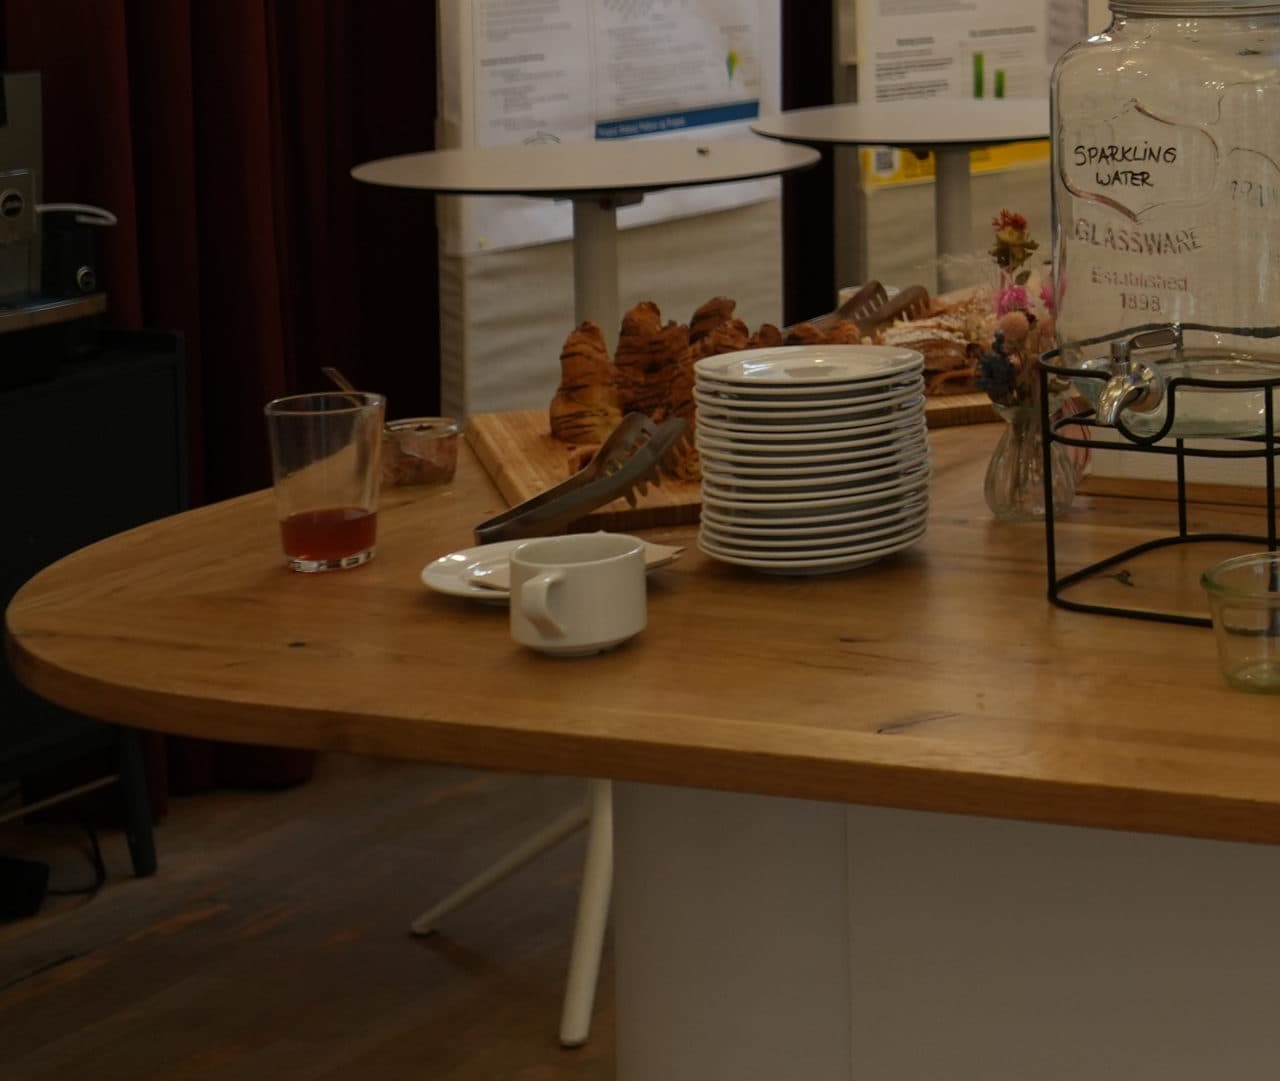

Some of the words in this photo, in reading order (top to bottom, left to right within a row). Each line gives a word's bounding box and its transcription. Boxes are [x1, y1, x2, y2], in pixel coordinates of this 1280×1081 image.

[1095, 170, 1155, 188] WATER
[1075, 217, 1204, 257] GLASSWARE
[1119, 292, 1162, 313] 1898
